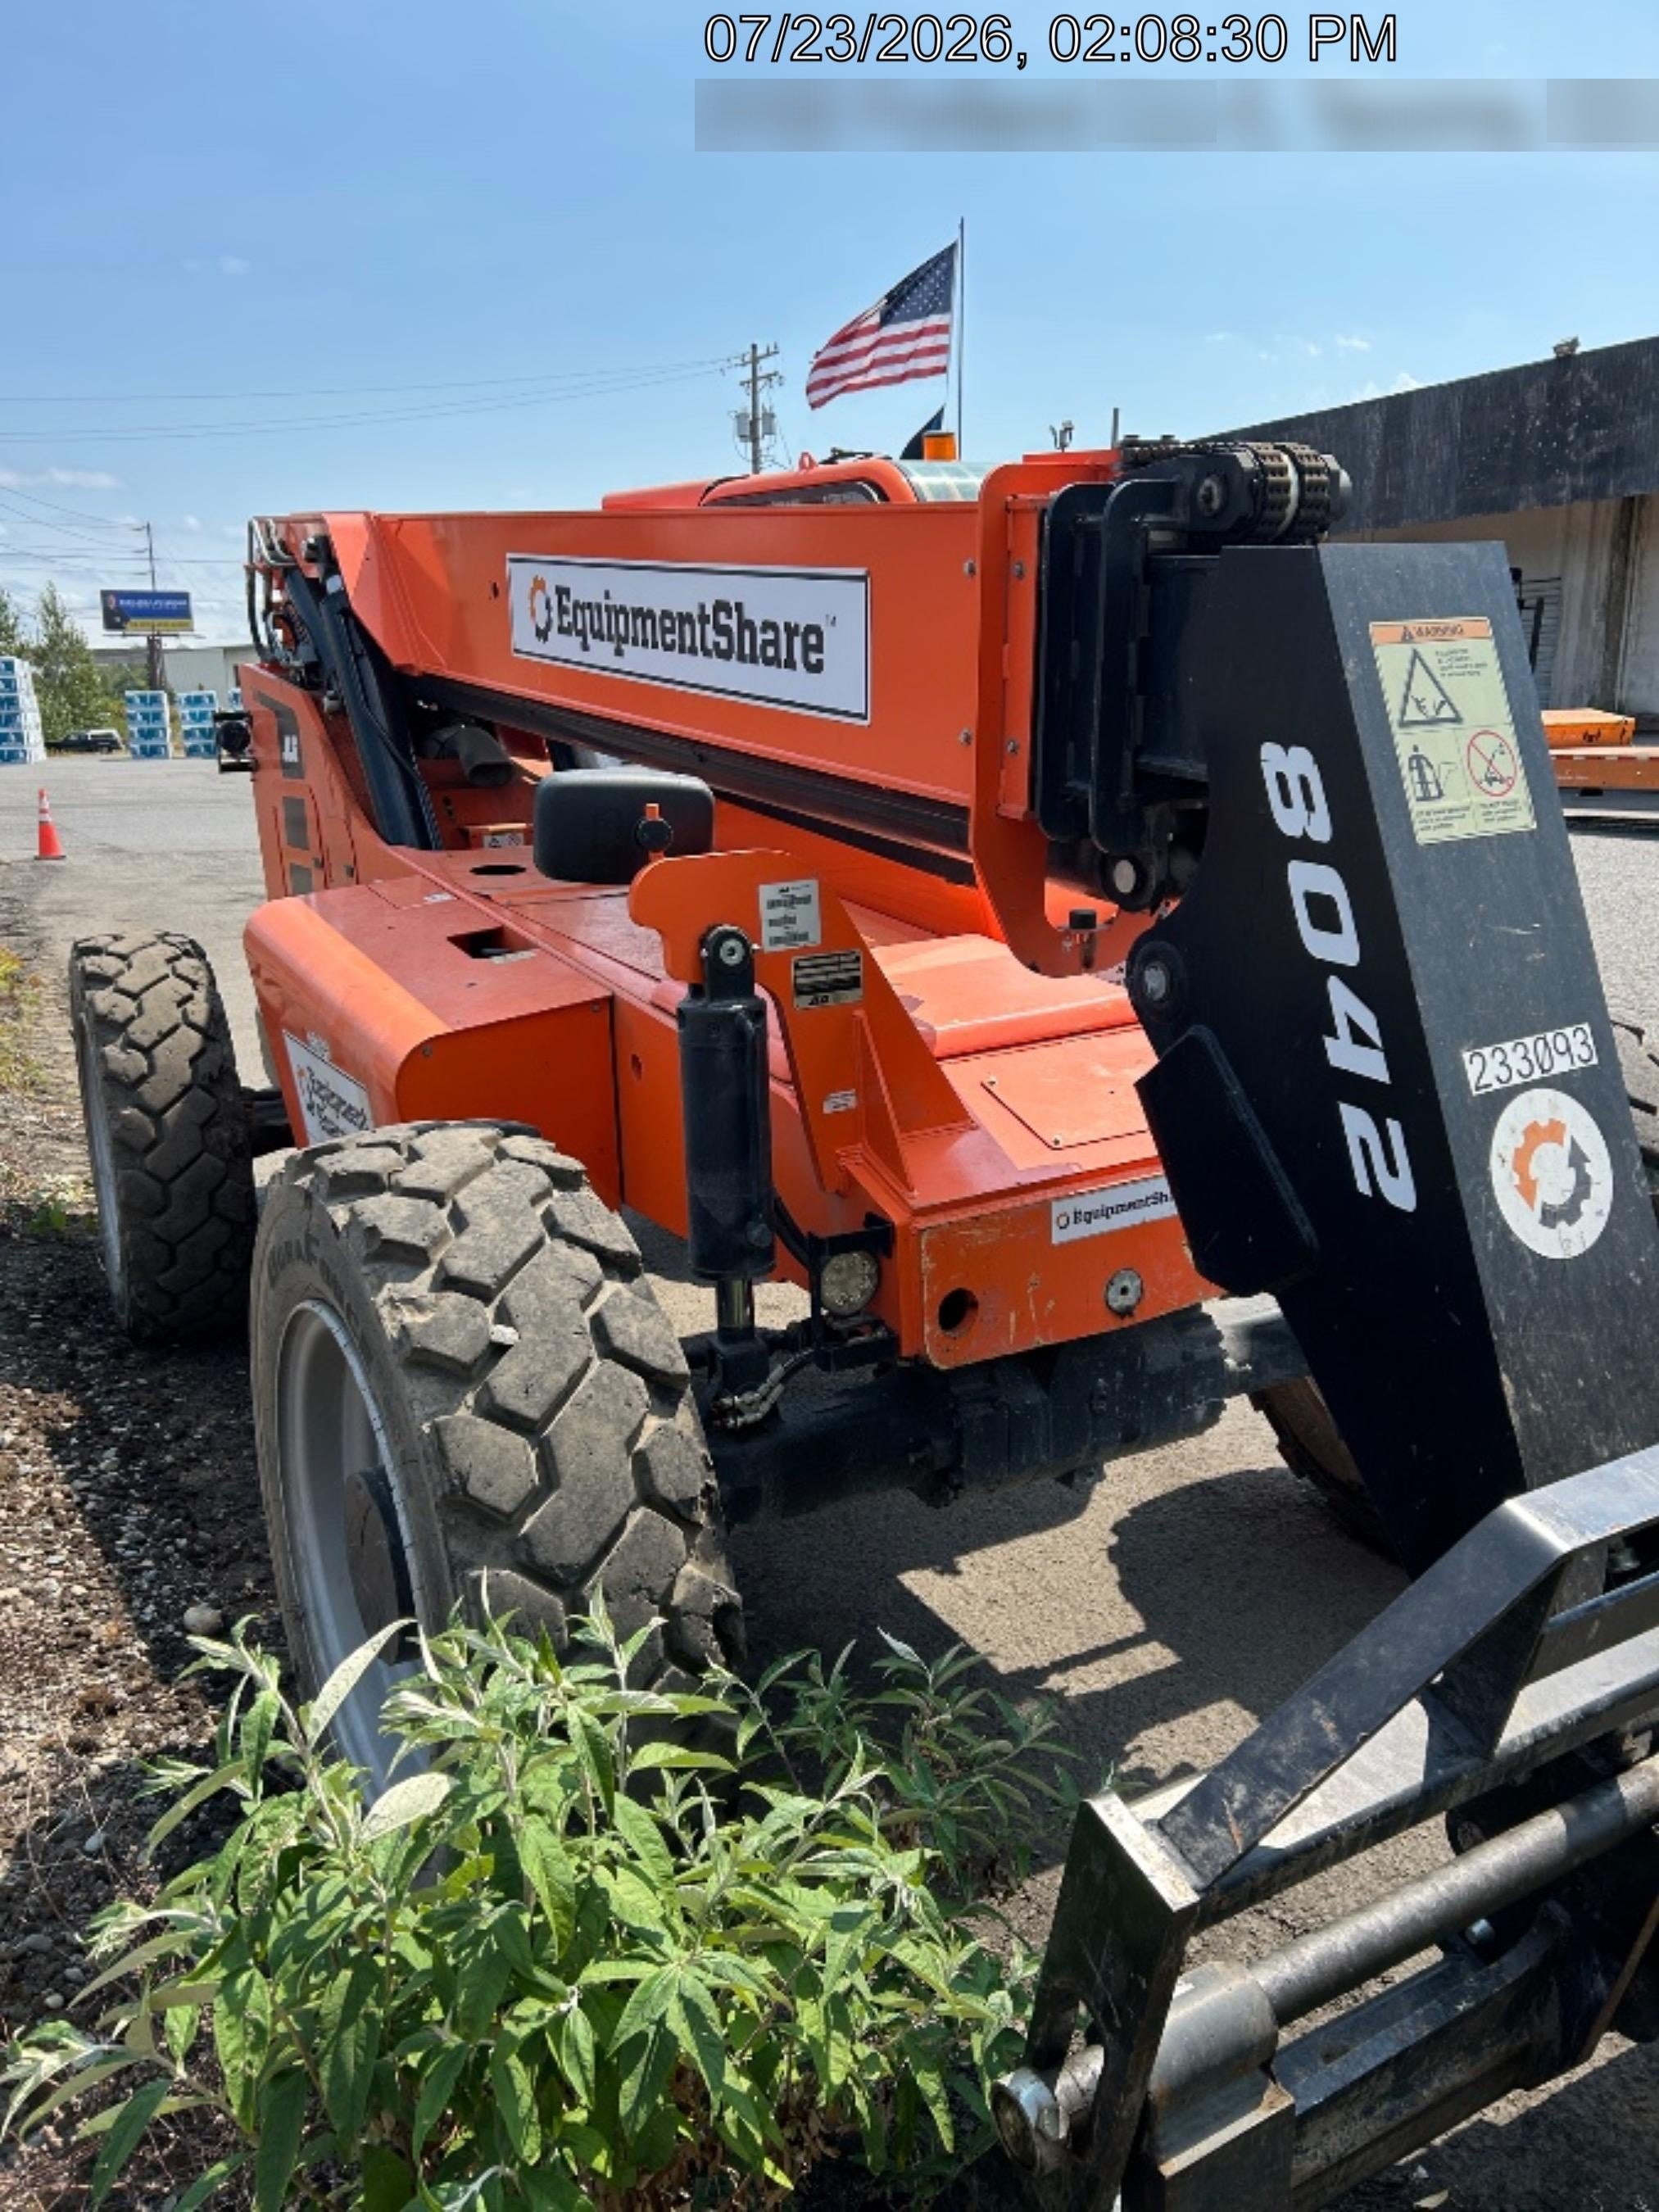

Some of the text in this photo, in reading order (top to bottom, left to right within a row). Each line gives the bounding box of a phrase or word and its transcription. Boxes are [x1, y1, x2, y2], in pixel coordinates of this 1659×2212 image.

[555, 584, 824, 674] EquipmentShare
[1260, 741, 1416, 1213] 8042
[1469, 1027, 1594, 1091] 233093
[1073, 1191, 1173, 1225] EquipmentSh
